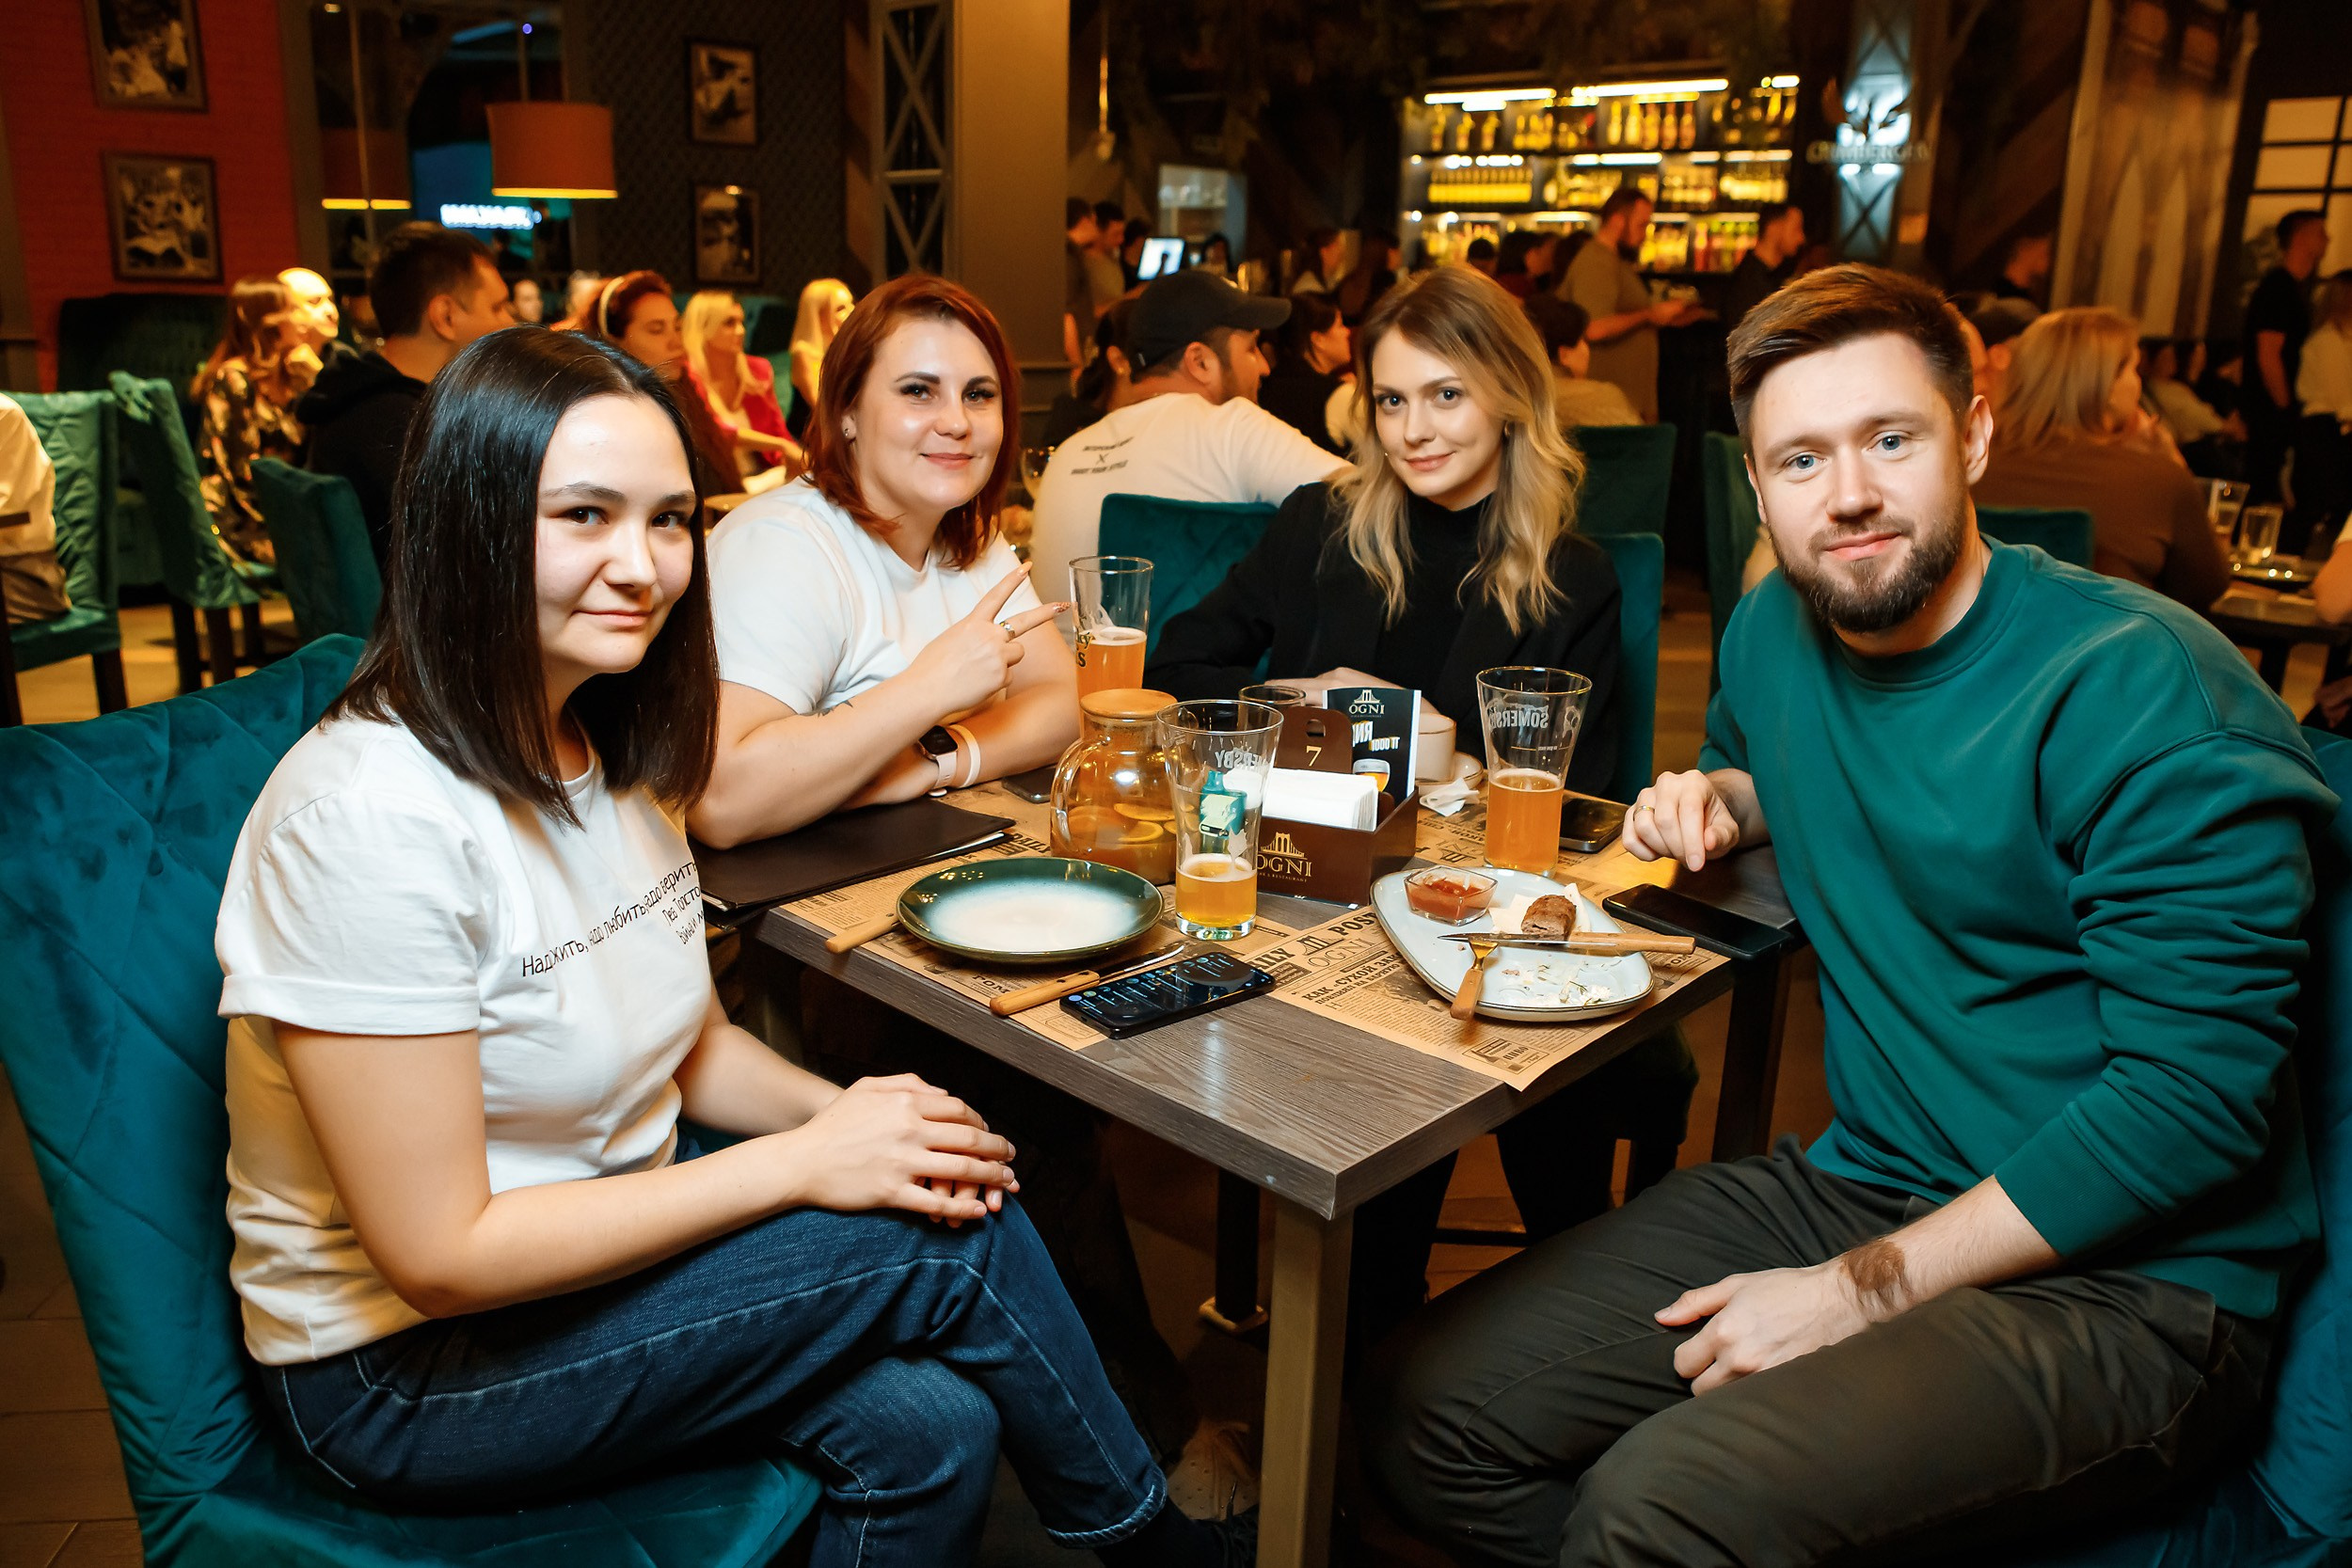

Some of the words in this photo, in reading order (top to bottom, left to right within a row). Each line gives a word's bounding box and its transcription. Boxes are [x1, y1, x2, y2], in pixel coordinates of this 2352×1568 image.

[1348, 704, 1385, 715] OGNI
[1307, 745, 1322, 767] 7
[1257, 854, 1311, 877] OGNI
[673, 886, 702, 912] Толсто
[1248, 946, 1295, 972] AILY
[1307, 938, 1376, 968] OGNI
[522, 954, 553, 977] Над
[1301, 986, 1334, 1002] КАК
